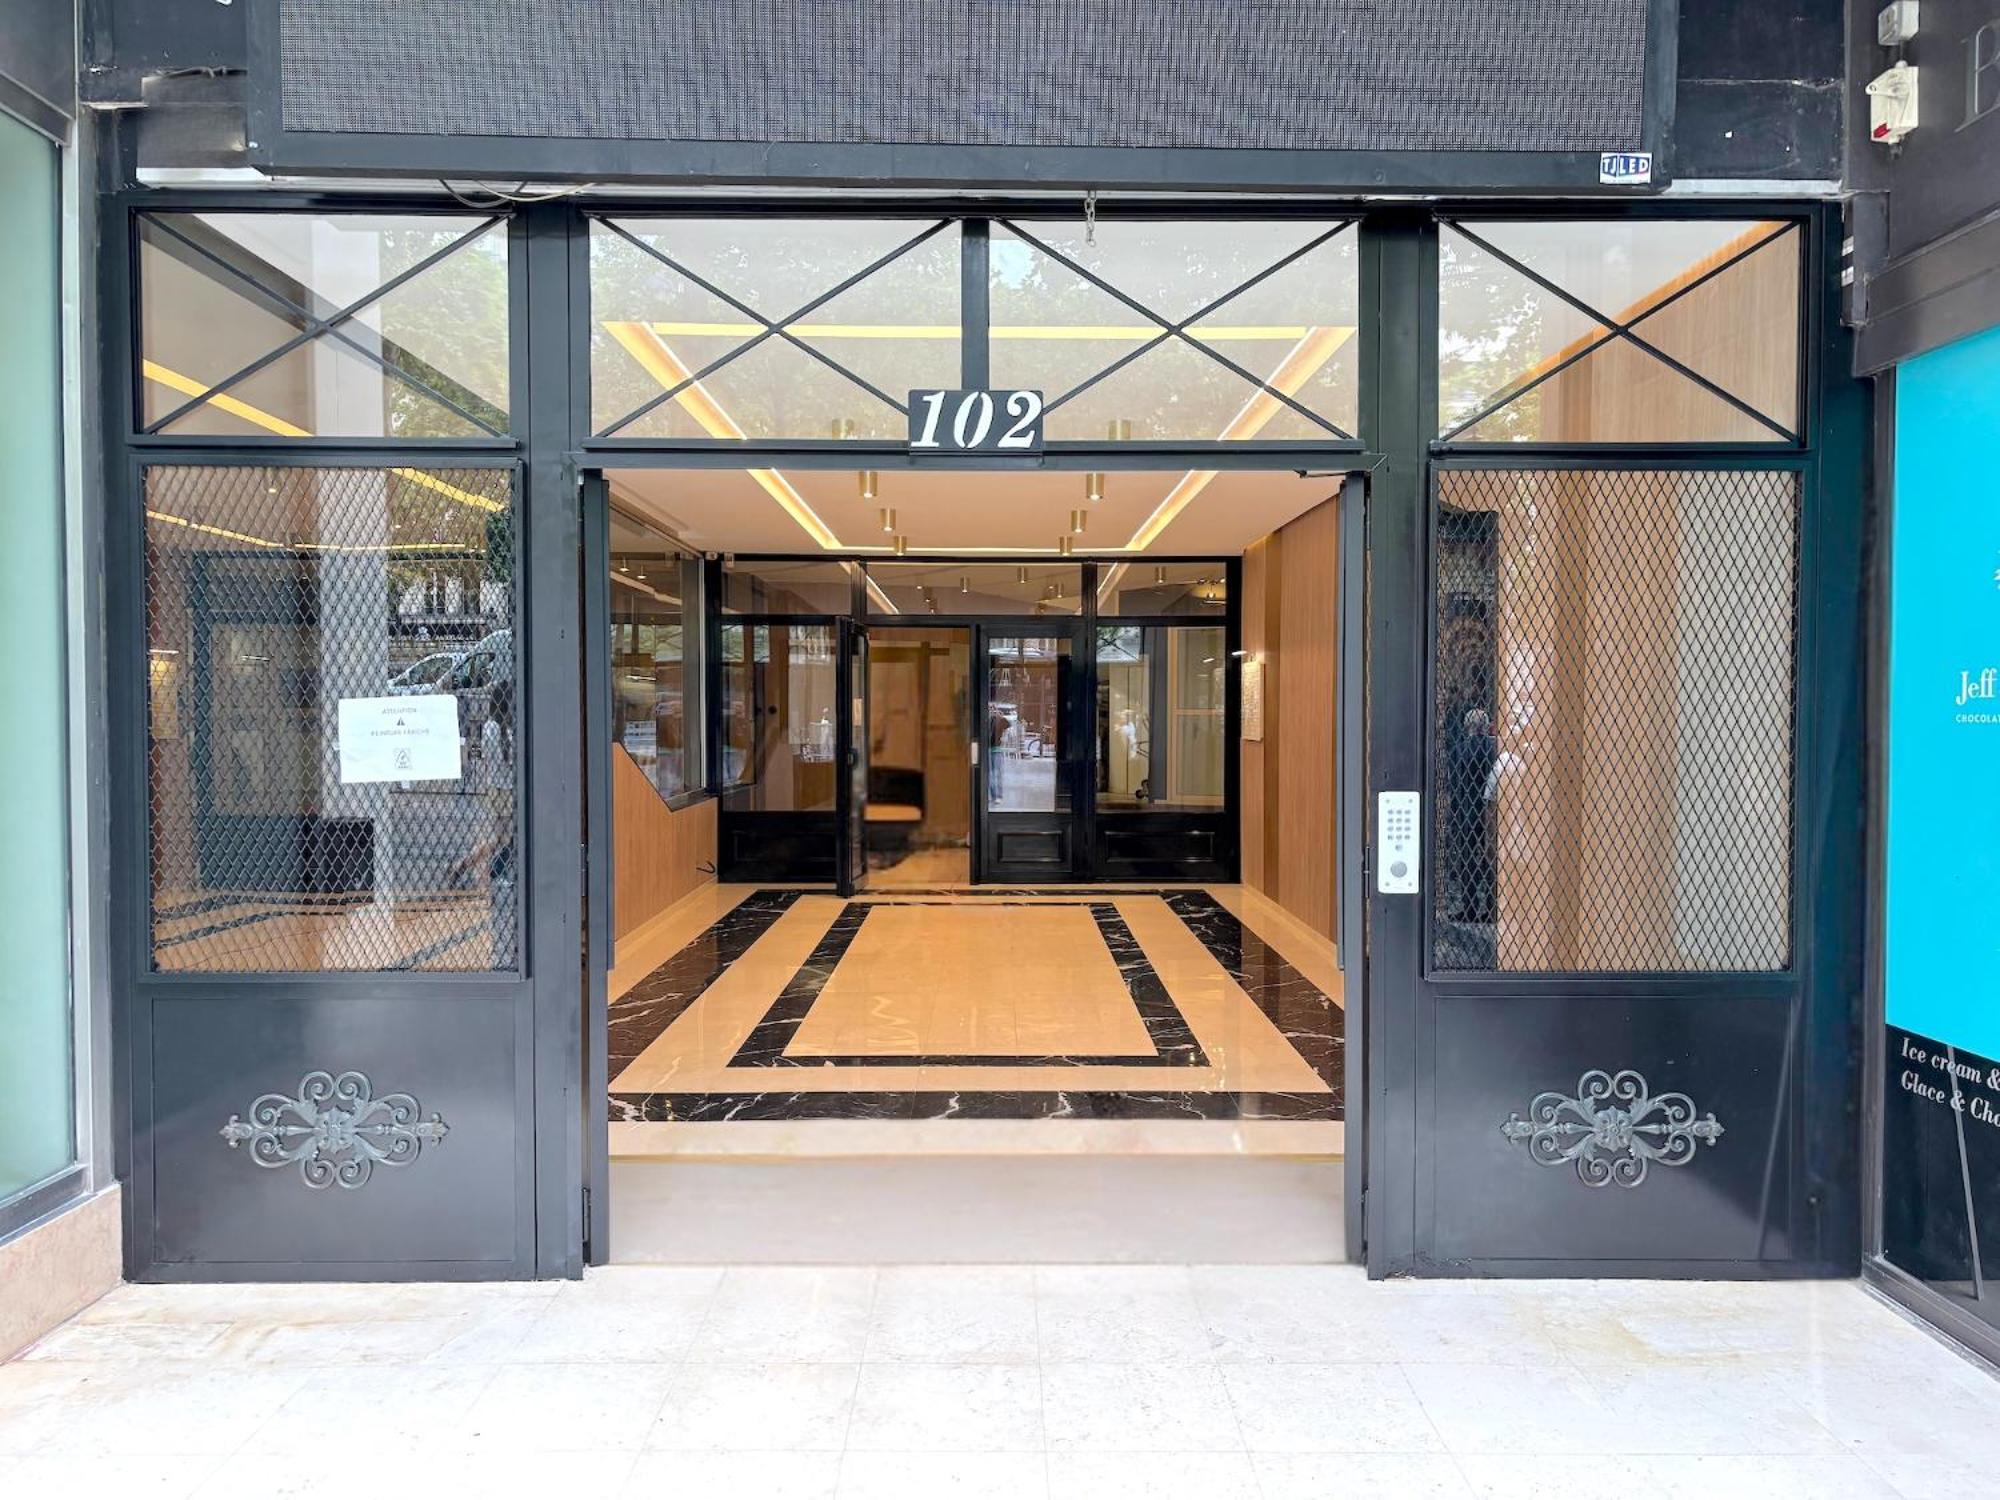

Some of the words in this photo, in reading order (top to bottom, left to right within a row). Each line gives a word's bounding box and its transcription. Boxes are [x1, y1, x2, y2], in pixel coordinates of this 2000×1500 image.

[911, 391, 1042, 448] 102
[1955, 668, 1997, 705] Jeff
[1901, 1037, 1927, 1063] Ice
[1931, 1054, 1982, 1083] cream
[1901, 1070, 1946, 1104] Glace
[1950, 1090, 1967, 1112] &
